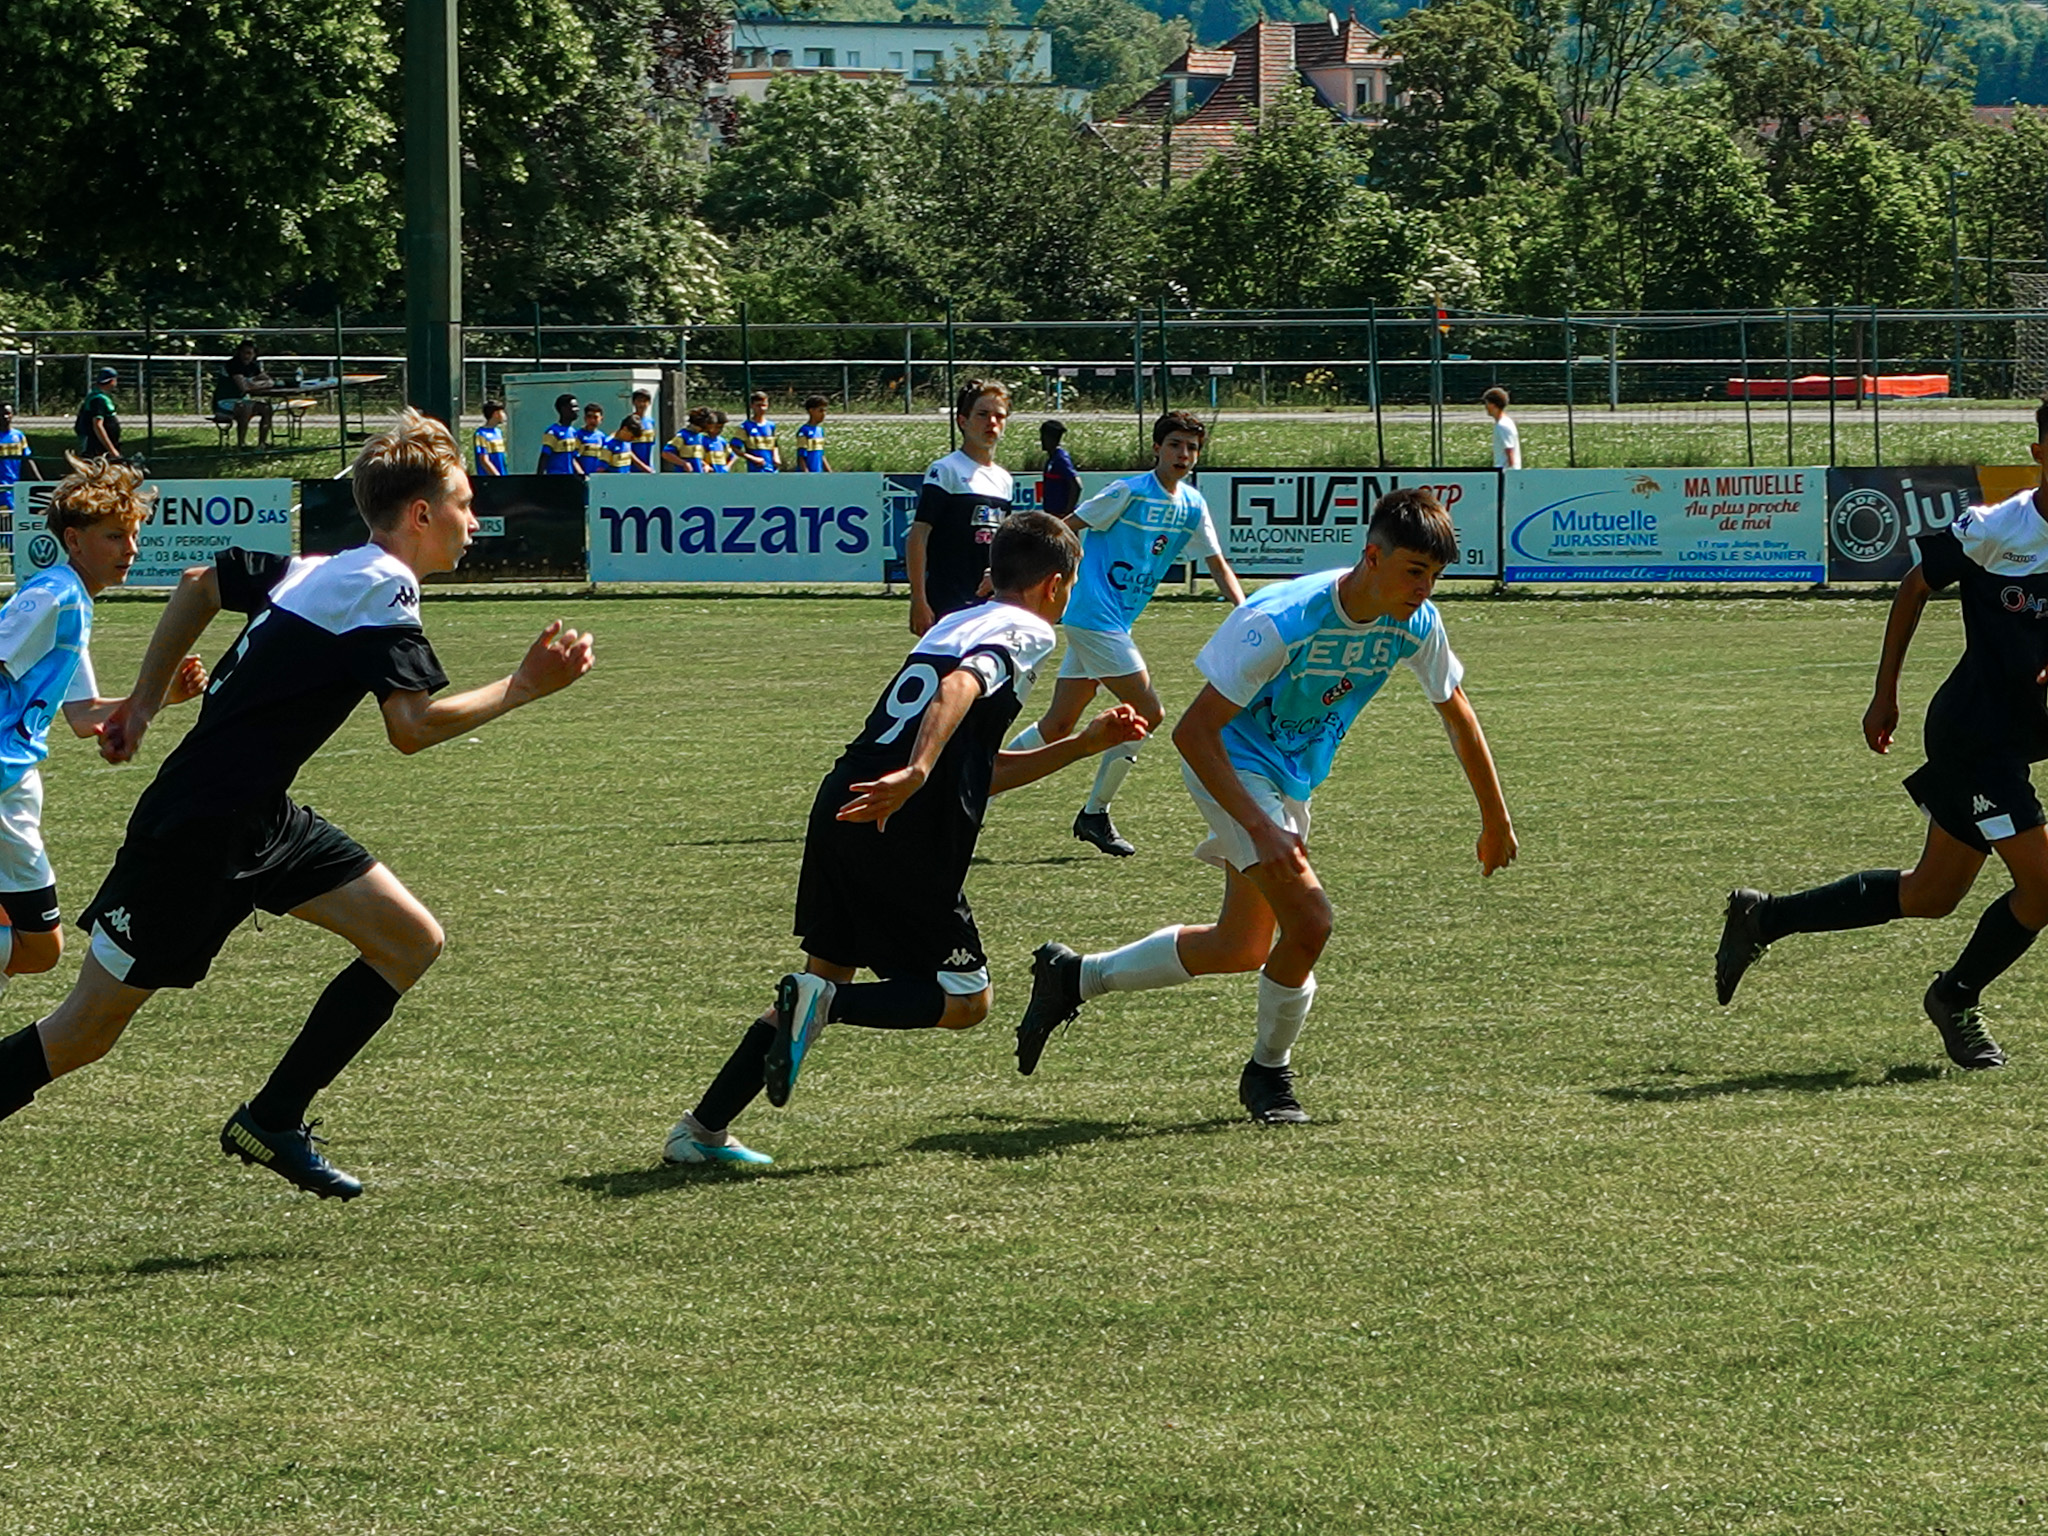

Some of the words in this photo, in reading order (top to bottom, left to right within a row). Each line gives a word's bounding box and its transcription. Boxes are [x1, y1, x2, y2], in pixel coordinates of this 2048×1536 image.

[1684, 477, 1711, 498] MA
[1715, 473, 1805, 497] MUTUELLE
[257, 509, 288, 524] SAS
[1684, 501, 1708, 518] Au
[1710, 501, 1745, 520] plus
[1746, 498, 1801, 519] proche
[1837, 496, 1878, 525] MADE
[1880, 505, 1894, 524] IN
[18, 521, 48, 531] SE
[600, 505, 869, 554] mazars
[1552, 509, 1657, 532] Mutuelle
[1719, 517, 1738, 531] de
[1741, 515, 1772, 530] moi
[1230, 528, 1353, 549] MAÇONNERIE
[1551, 533, 1659, 548] JURASSIENNE
[1844, 540, 1886, 555] JURA
[1467, 549, 1485, 565] 91
[1679, 551, 1718, 561] LONS
[1721, 551, 1740, 561] LE
[1743, 550, 1807, 561] SAUNIER
[1514, 567, 1813, 581] www.mutuelle-jurassienne.com
[874, 663, 940, 745] 9
[227, 1122, 276, 1163] PUMA
